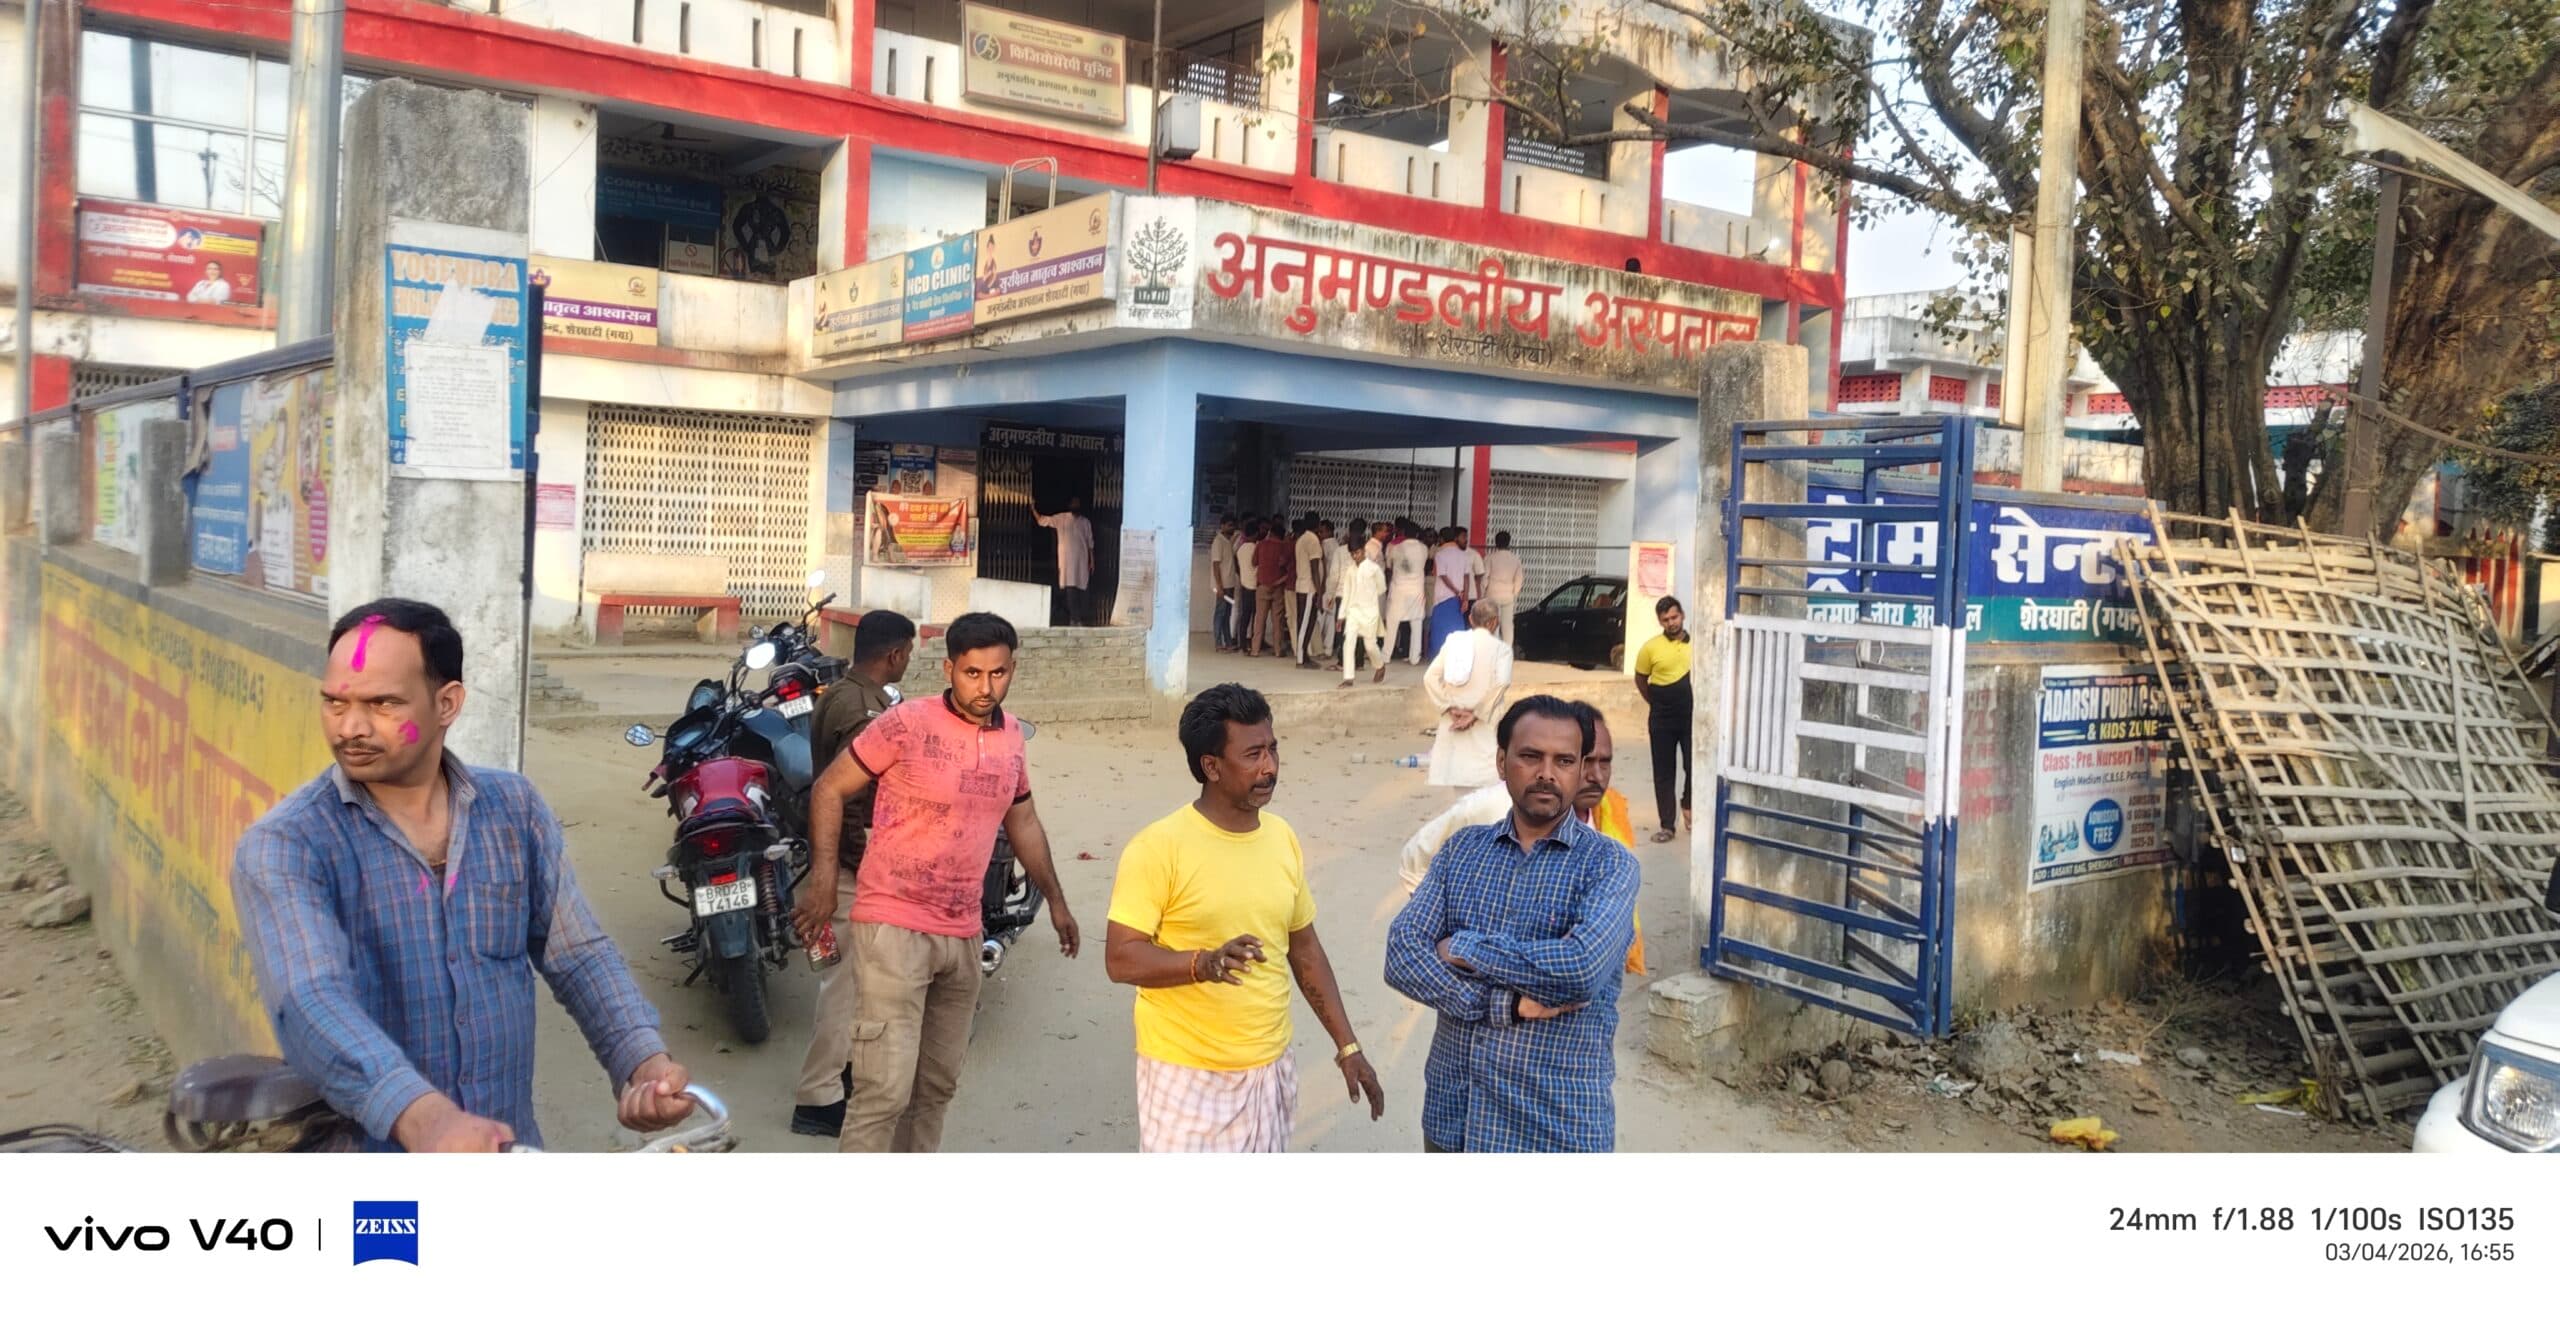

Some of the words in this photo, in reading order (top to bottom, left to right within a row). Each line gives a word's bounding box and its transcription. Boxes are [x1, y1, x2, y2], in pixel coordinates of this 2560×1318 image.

[1058, 252, 1103, 275] आश्वासन
[931, 263, 971, 291] CLINIC
[1207, 232, 1564, 340] अनुमण्डलीय
[583, 305, 652, 324] आश्वासन
[2020, 597, 2091, 632] शेरघाटी
[2042, 687, 2098, 722] ADARSH
[2100, 686, 2148, 719] PUBLIC
[2087, 723, 2097, 741] &
[2100, 722, 2126, 740] KIDS
[2096, 747, 2132, 767] Nursery
[2092, 826, 2113, 845] FREE
